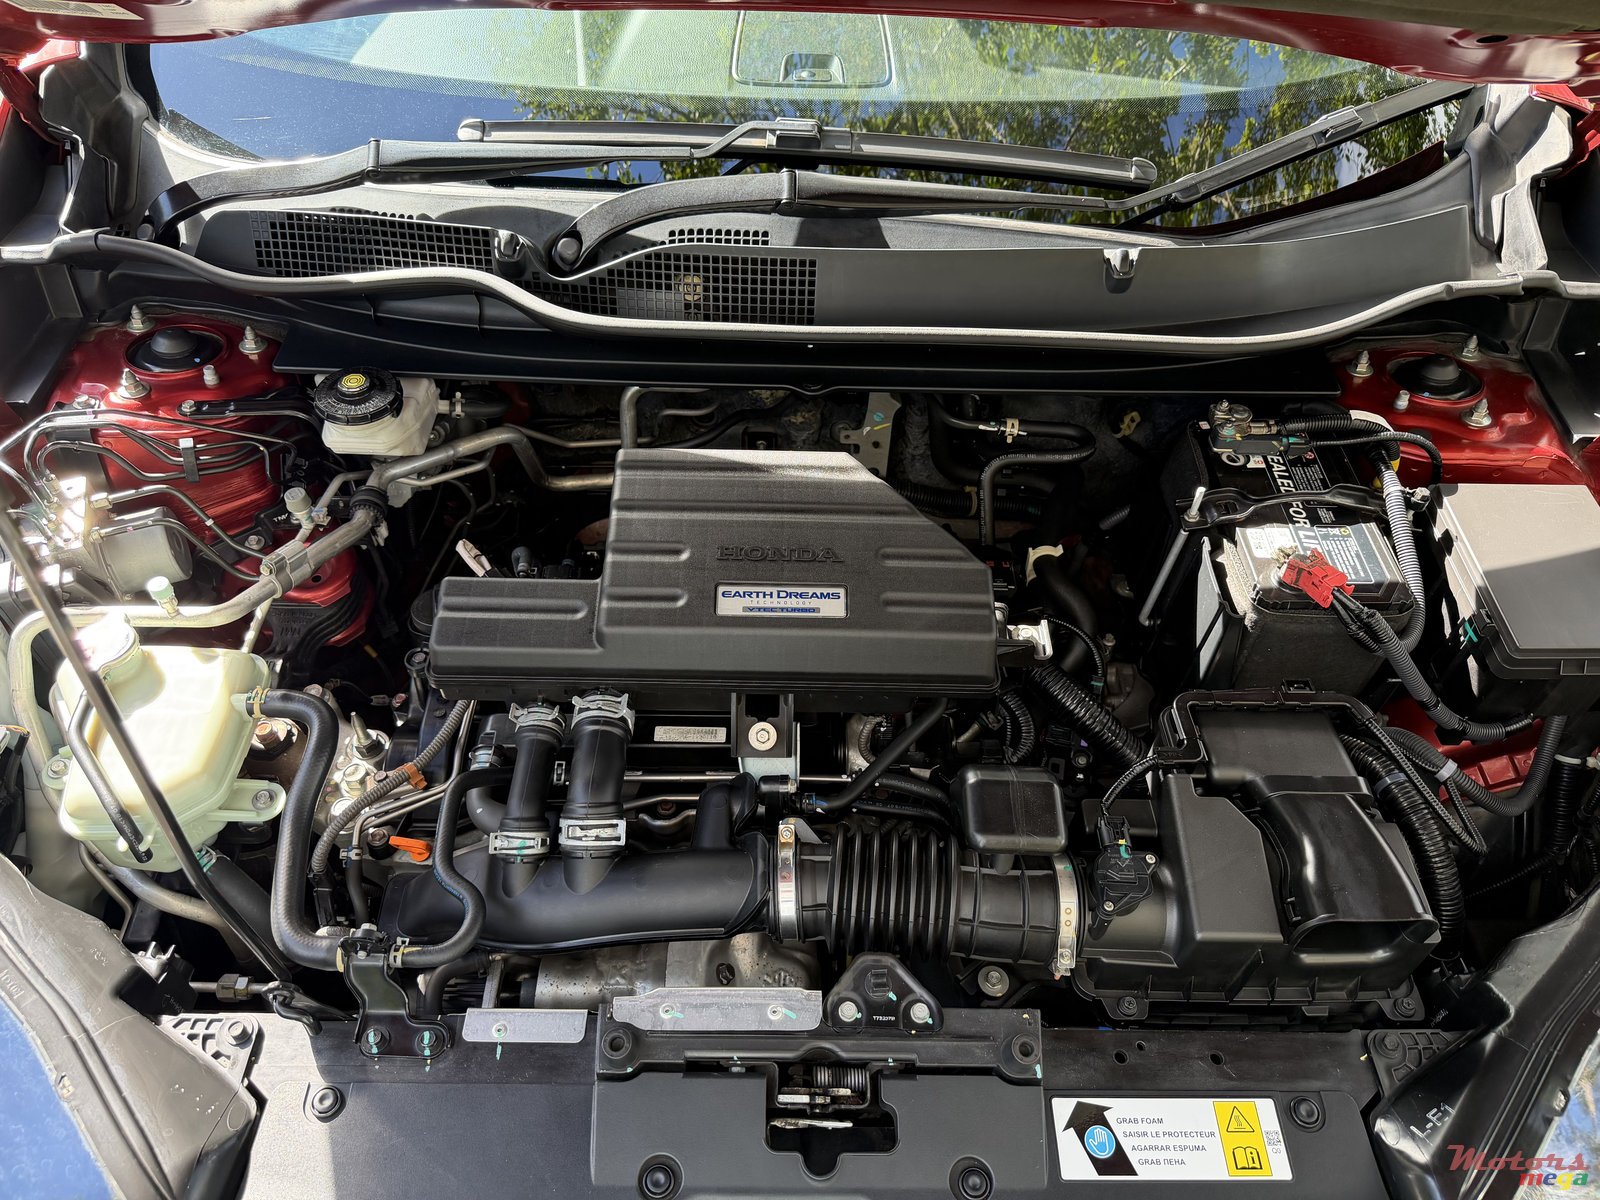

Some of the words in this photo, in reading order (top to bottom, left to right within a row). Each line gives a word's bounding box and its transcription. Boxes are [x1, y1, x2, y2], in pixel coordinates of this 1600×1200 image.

[1288, 500, 1311, 528] FOR
[717, 546, 844, 562] HONDA
[721, 590, 774, 599] EARTH
[777, 590, 841, 600] DREAMS
